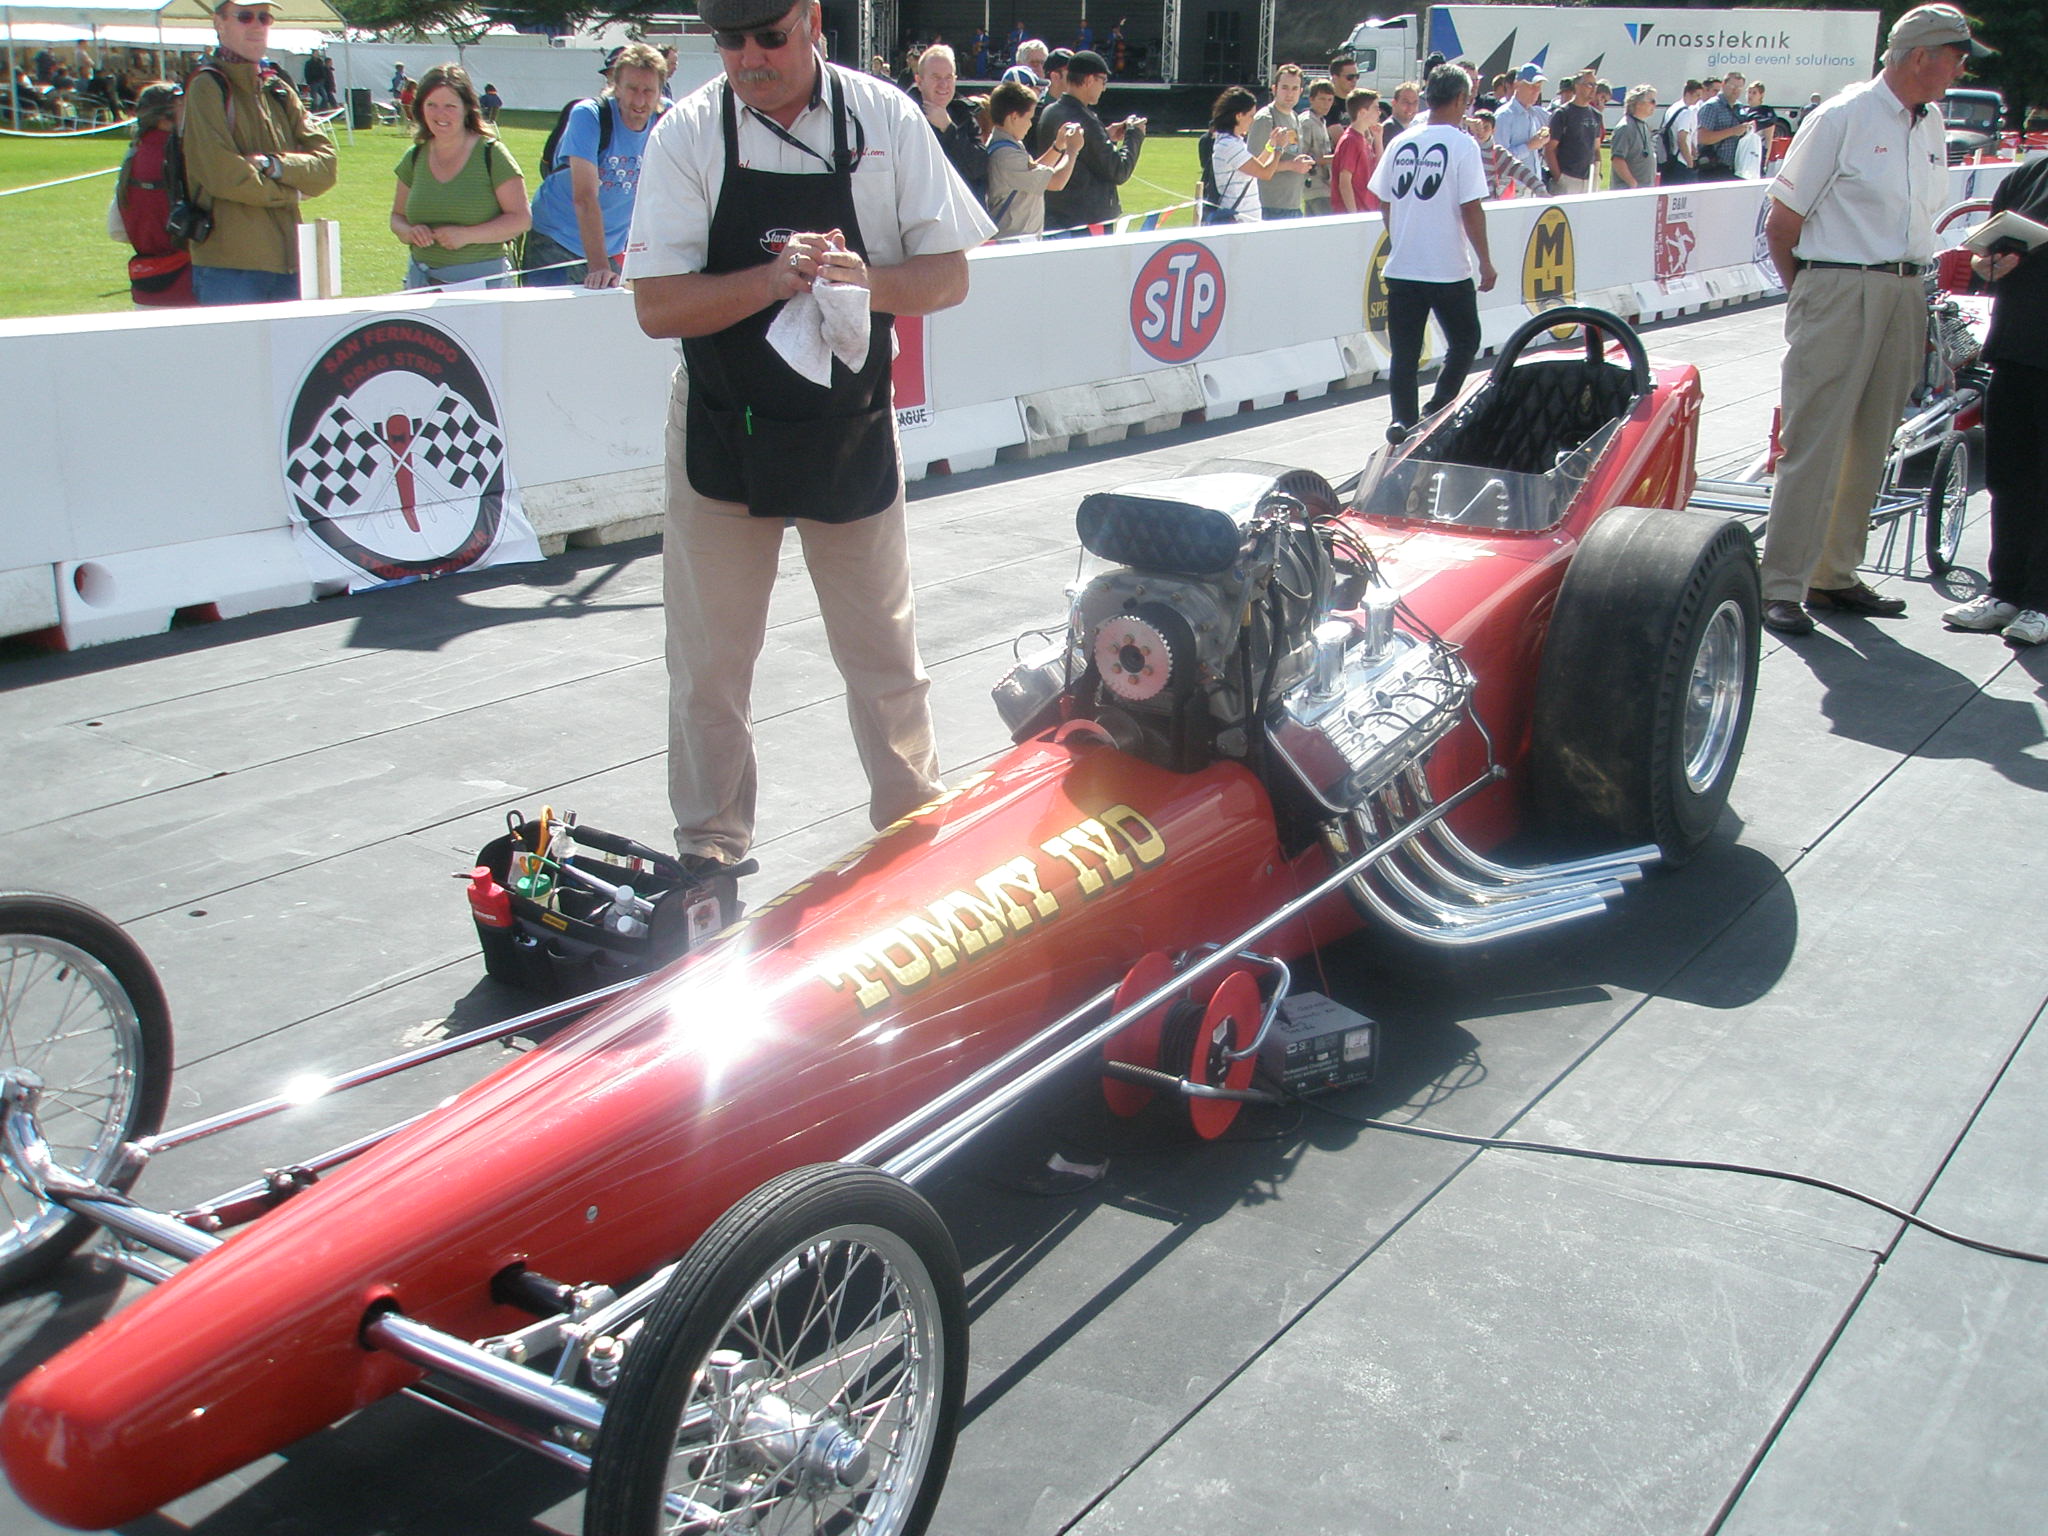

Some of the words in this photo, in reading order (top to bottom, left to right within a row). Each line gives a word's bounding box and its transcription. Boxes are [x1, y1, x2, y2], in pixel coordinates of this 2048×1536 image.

[1656, 29, 1791, 49] massteknik
[1707, 52, 1751, 67] global
[1754, 53, 1791, 65] event
[1795, 53, 1855, 67] solutions
[1534, 221, 1566, 269] M
[1140, 251, 1217, 347] STP
[322, 340, 361, 374] SAN
[363, 326, 459, 364] FERNANDO
[342, 354, 389, 389] DRAG
[393, 352, 443, 375] STRIP
[818, 855, 1062, 1010] TOMMY
[1040, 803, 1168, 900] IVO
